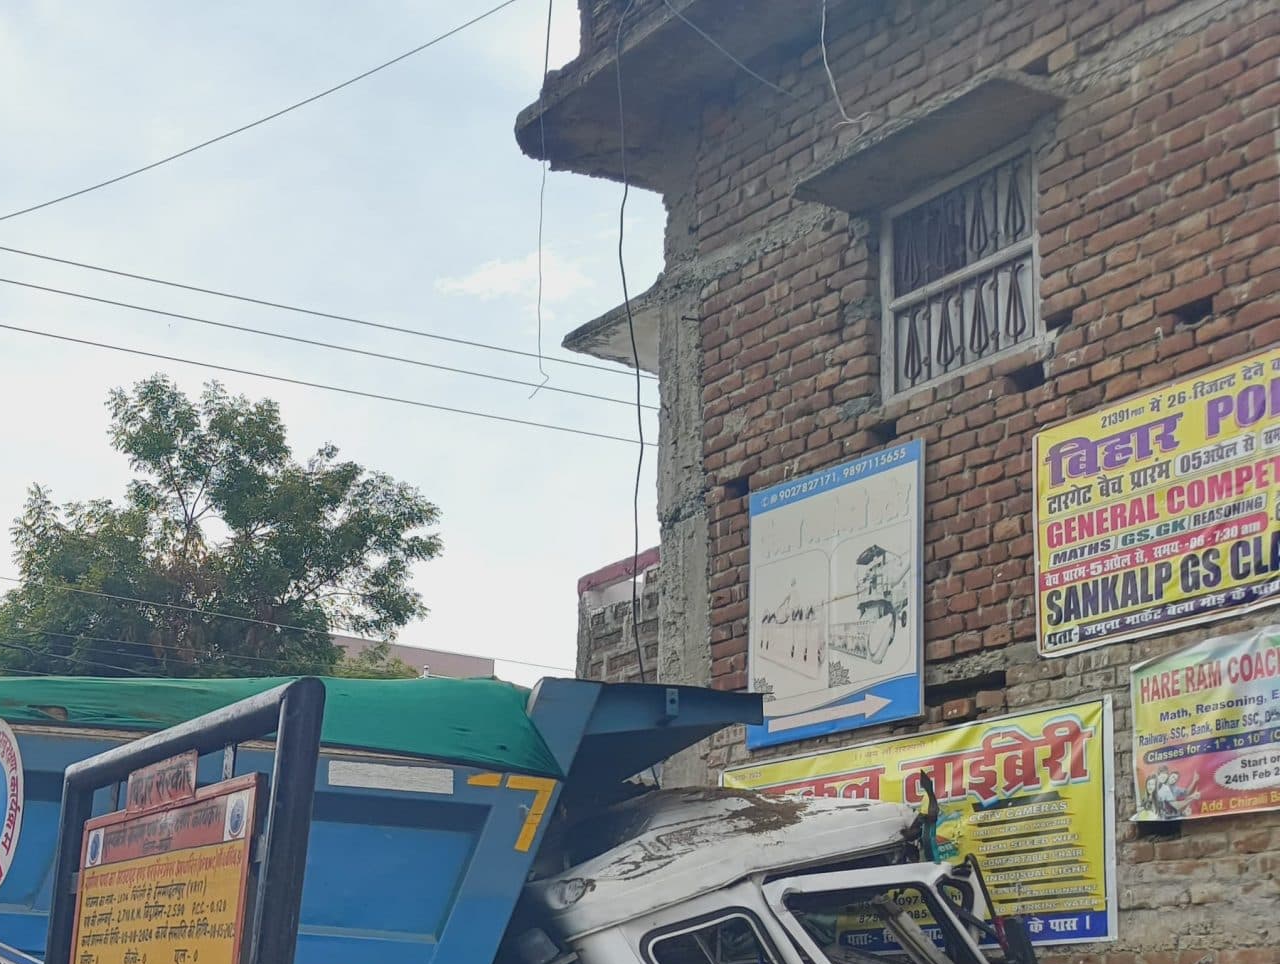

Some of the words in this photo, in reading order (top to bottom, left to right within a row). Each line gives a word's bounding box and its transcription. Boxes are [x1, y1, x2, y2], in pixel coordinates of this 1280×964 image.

[1047, 493, 1159, 549] GENERAL
[1052, 538, 1111, 567] MATHS
[1193, 496, 1262, 526] REASONING
[1046, 561, 1172, 627] SANKALP
[1180, 548, 1222, 593] GS
[1140, 669, 1181, 704] HARE
[1184, 661, 1223, 693] RAM
[1160, 707, 1192, 722] Math,
[1195, 694, 1267, 714] Reasoning,
[1215, 718, 1240, 731] Bihar
[1147, 748, 1184, 762] Classes
[1187, 743, 1200, 755] for
[1241, 756, 1267, 769] Start
[1224, 773, 1249, 785] 24th
[1252, 769, 1271, 780] Feb
[1006, 802, 1069, 818] CAMERAS
[1028, 917, 1044, 933] के
[1048, 917, 1078, 932] पास
